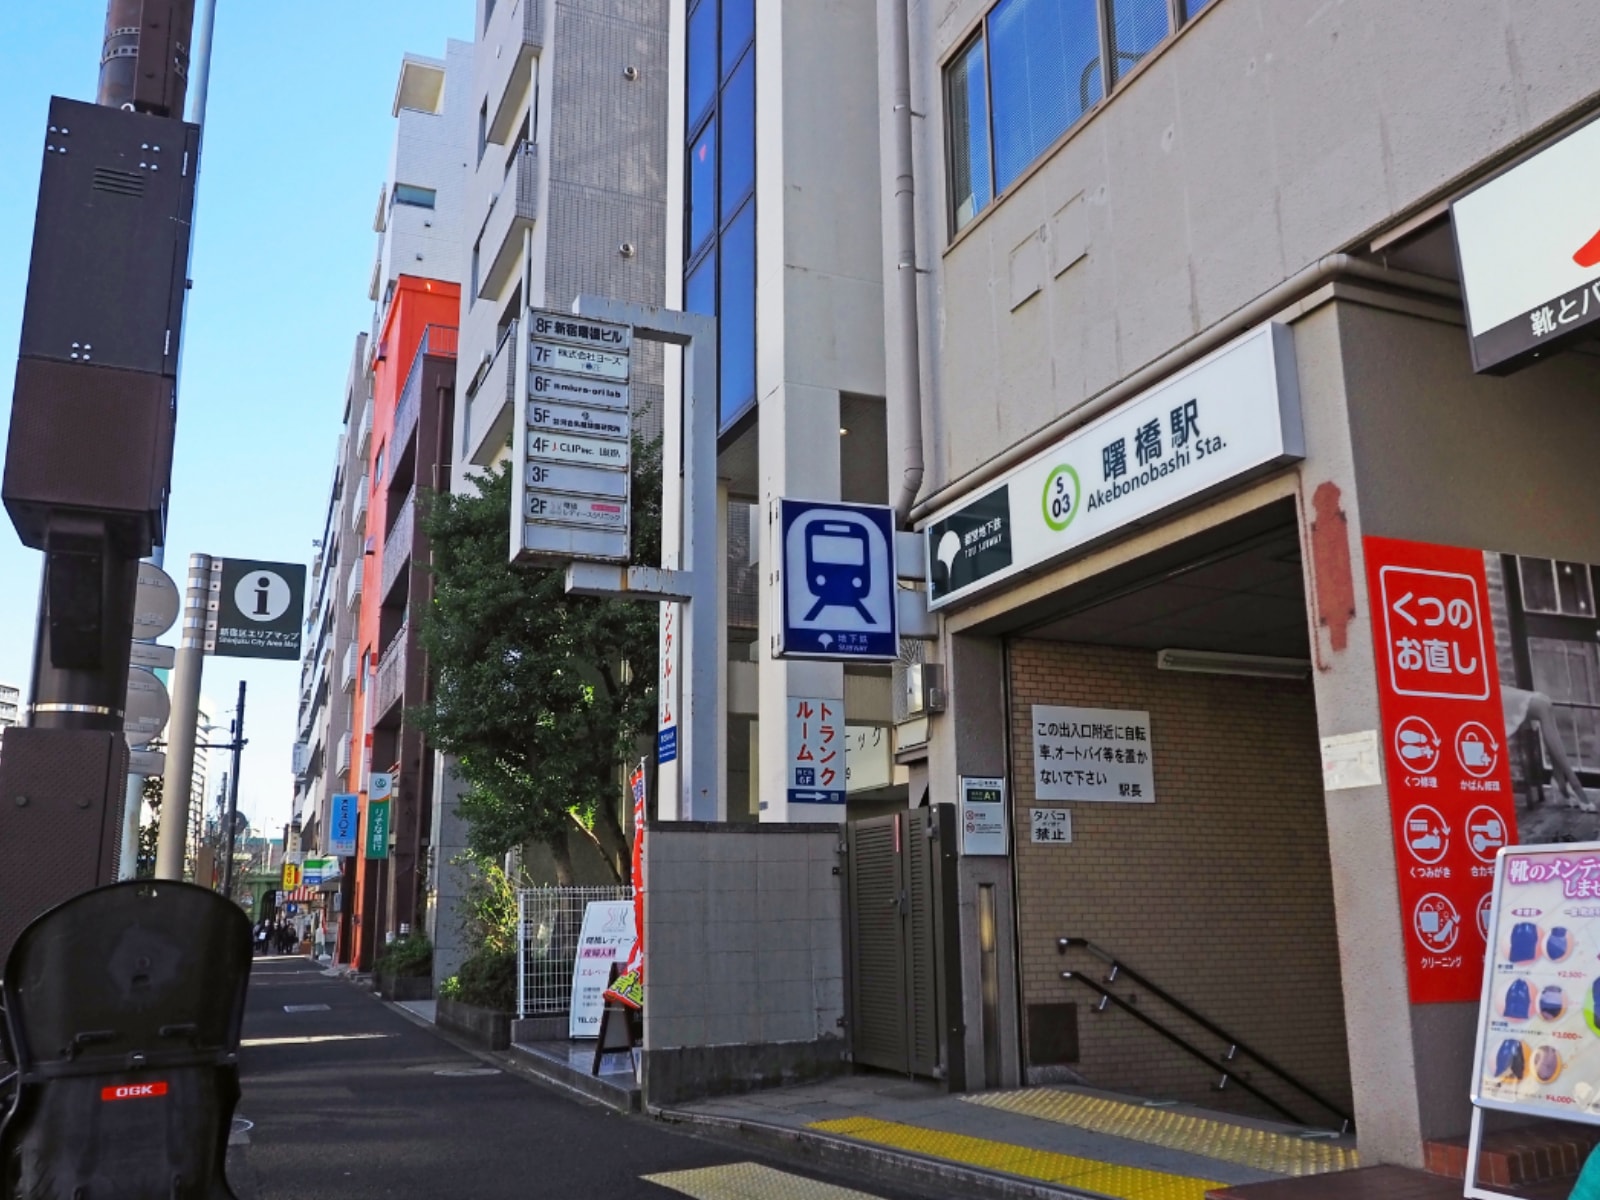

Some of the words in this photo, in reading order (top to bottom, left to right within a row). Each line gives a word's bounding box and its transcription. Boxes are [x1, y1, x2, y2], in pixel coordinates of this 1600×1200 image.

[536, 318, 553, 334] 8F
[535, 347, 552, 362] 7F
[535, 376, 551, 392] 6F
[533, 408, 550, 424] 5F
[532, 437, 550, 452] 4F
[1102, 398, 1200, 482] 曙橋駅
[532, 466, 549, 482] 3F
[1087, 446, 1191, 512] Akebonobashi
[1195, 435, 1226, 460] Sta.
[1056, 476, 1064, 494] S
[531, 498, 547, 514] 2F
[1052, 495, 1071, 518] 03
[1392, 591, 1473, 630] くつの
[1396, 635, 1477, 675] お直し
[796, 701, 813, 761] ルーム
[1037, 722, 1147, 742] この出入口附近に自転
[819, 702, 836, 786] トランク
[1040, 769, 1107, 785] ないで下さい
[1118, 783, 1142, 798] 駅長
[1034, 810, 1066, 822] タバコ
[373, 808, 384, 852] りそな銀行
[1035, 827, 1066, 840] 禁止
[1410, 866, 1451, 878] くつみがき
[1510, 858, 1600, 882] 靴のメンテ
[1421, 955, 1462, 969] クリーニング
[116, 1085, 153, 1097] OGK
